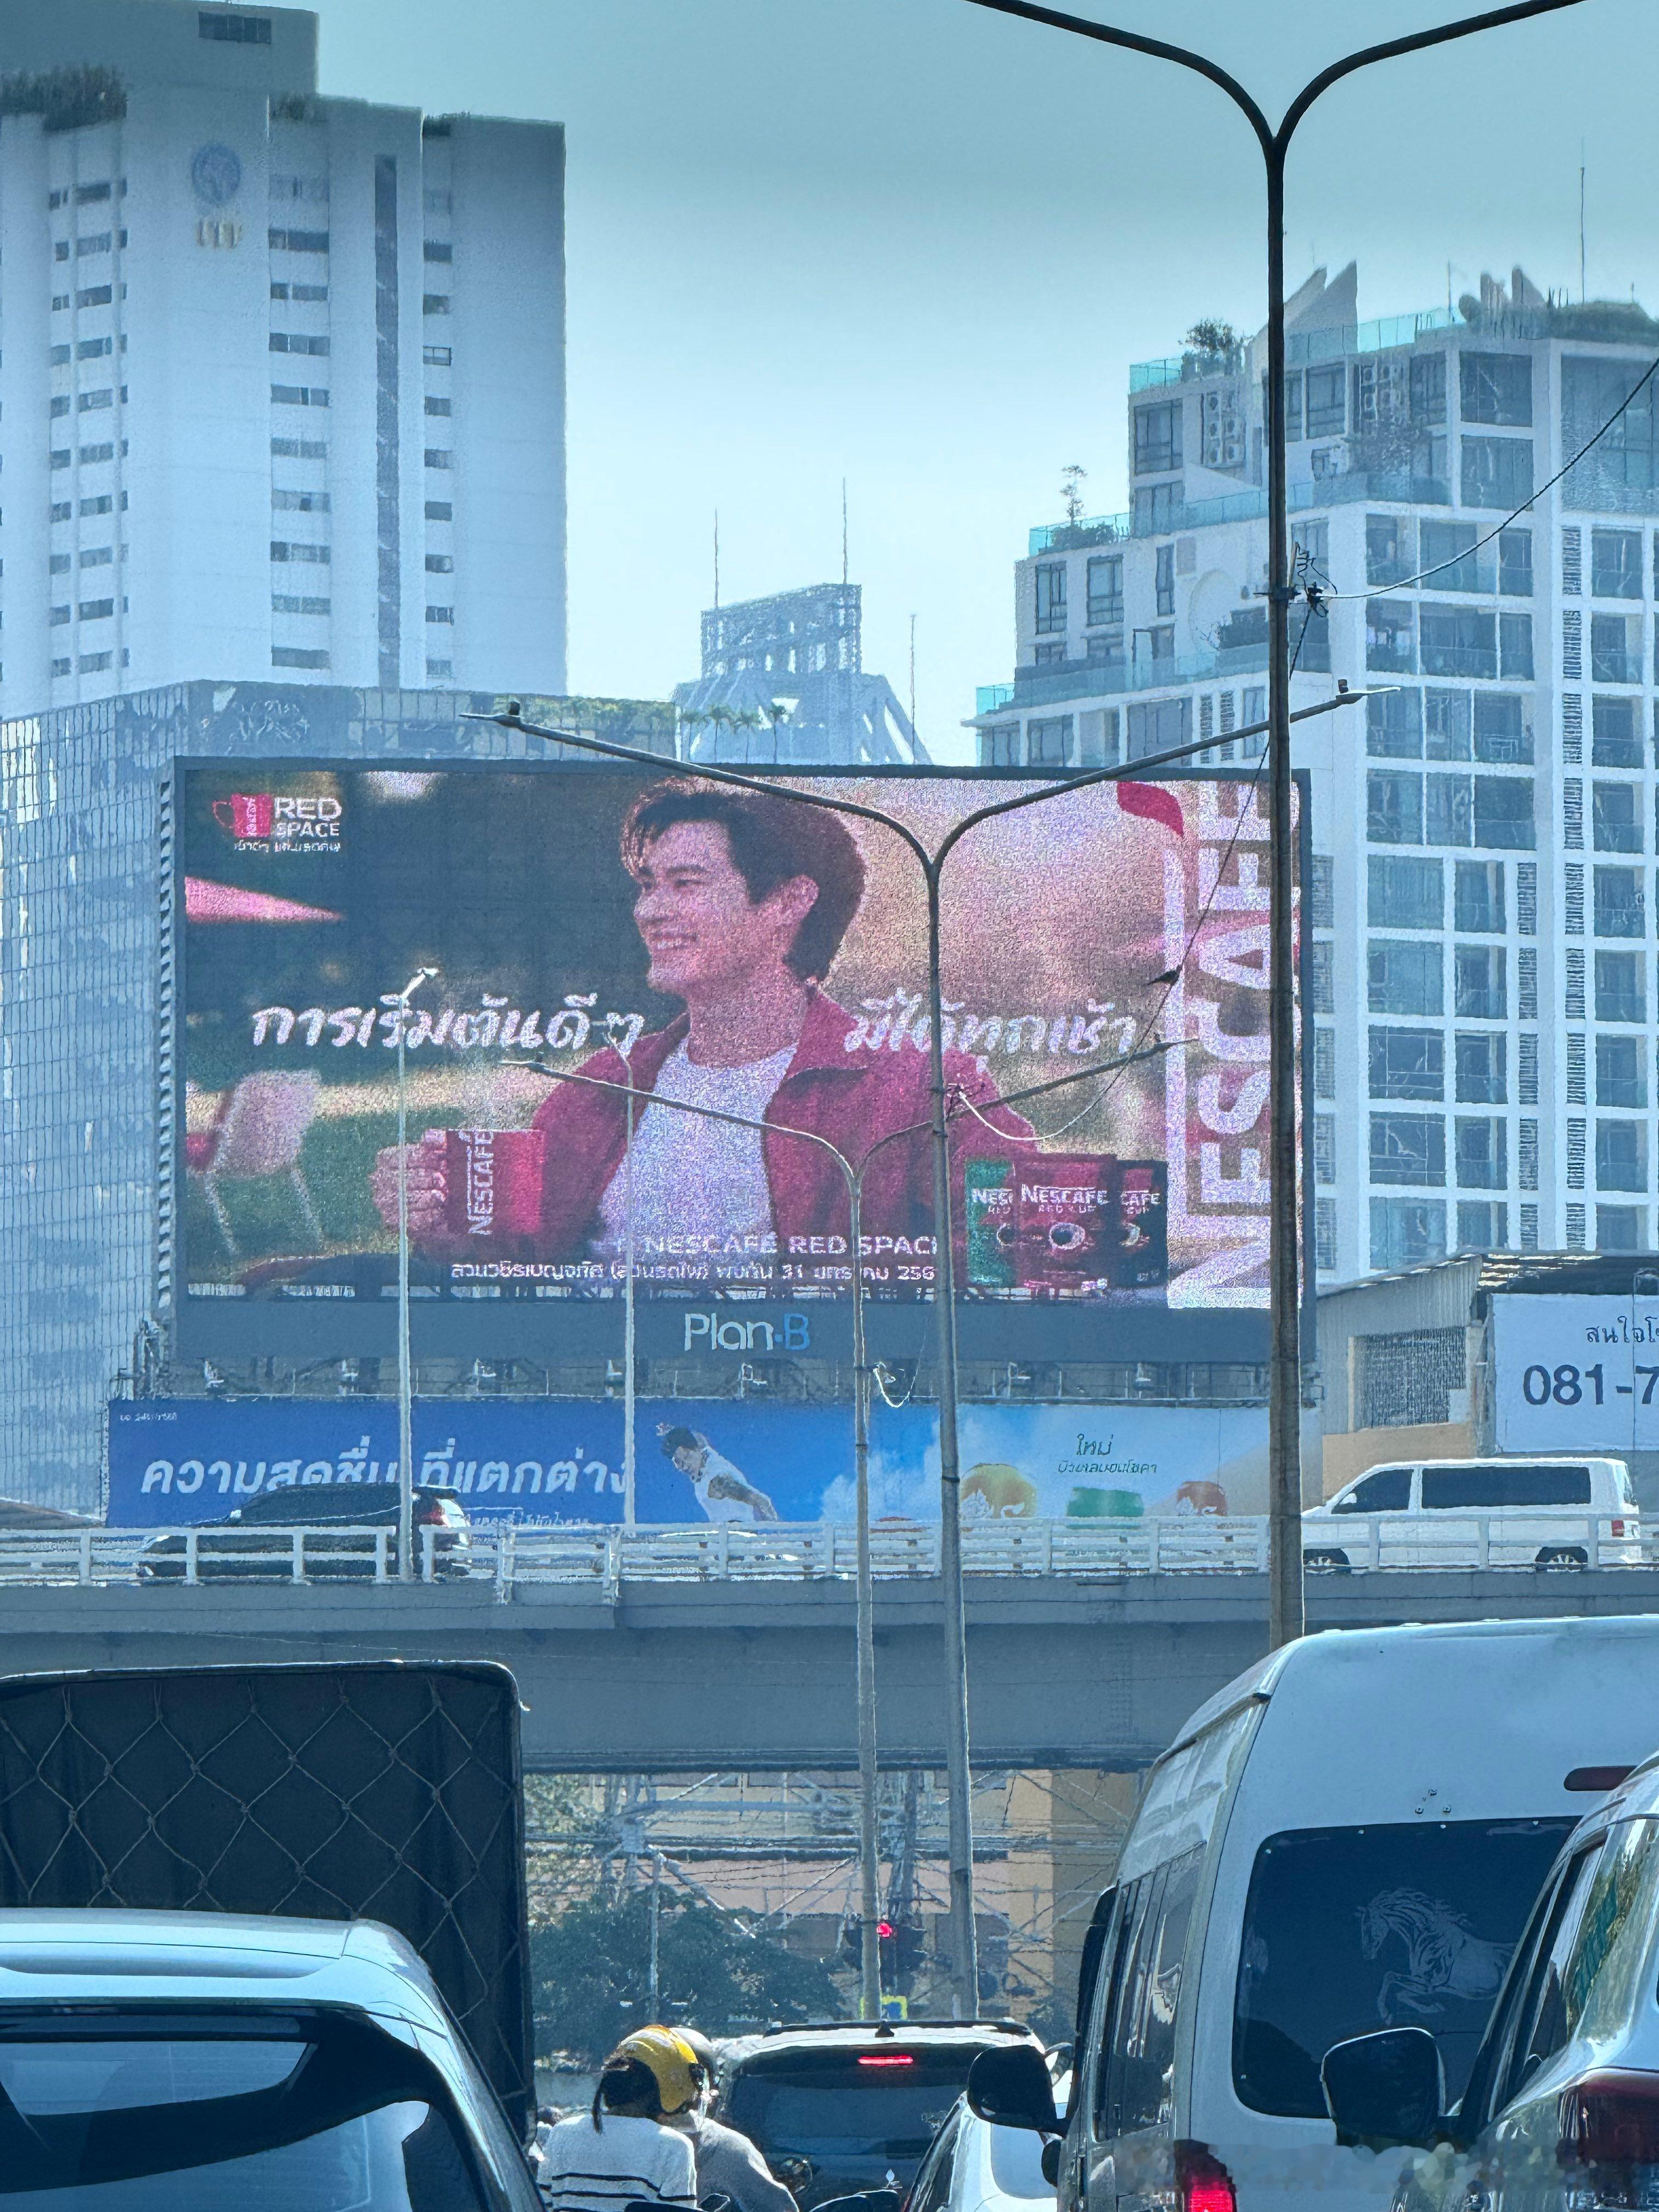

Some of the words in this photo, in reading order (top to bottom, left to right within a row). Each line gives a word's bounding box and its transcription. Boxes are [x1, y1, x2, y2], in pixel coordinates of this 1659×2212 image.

[274, 797, 342, 821] RED
[275, 822, 340, 837] SPACE
[789, 1235, 847, 1254] RED
[858, 1235, 938, 1255] SPAC
[781, 1264, 804, 1279] 31
[898, 1265, 936, 1280] 256
[1585, 1315, 1659, 1344] สนใจโ
[1076, 1433, 1114, 1456] ใหม่
